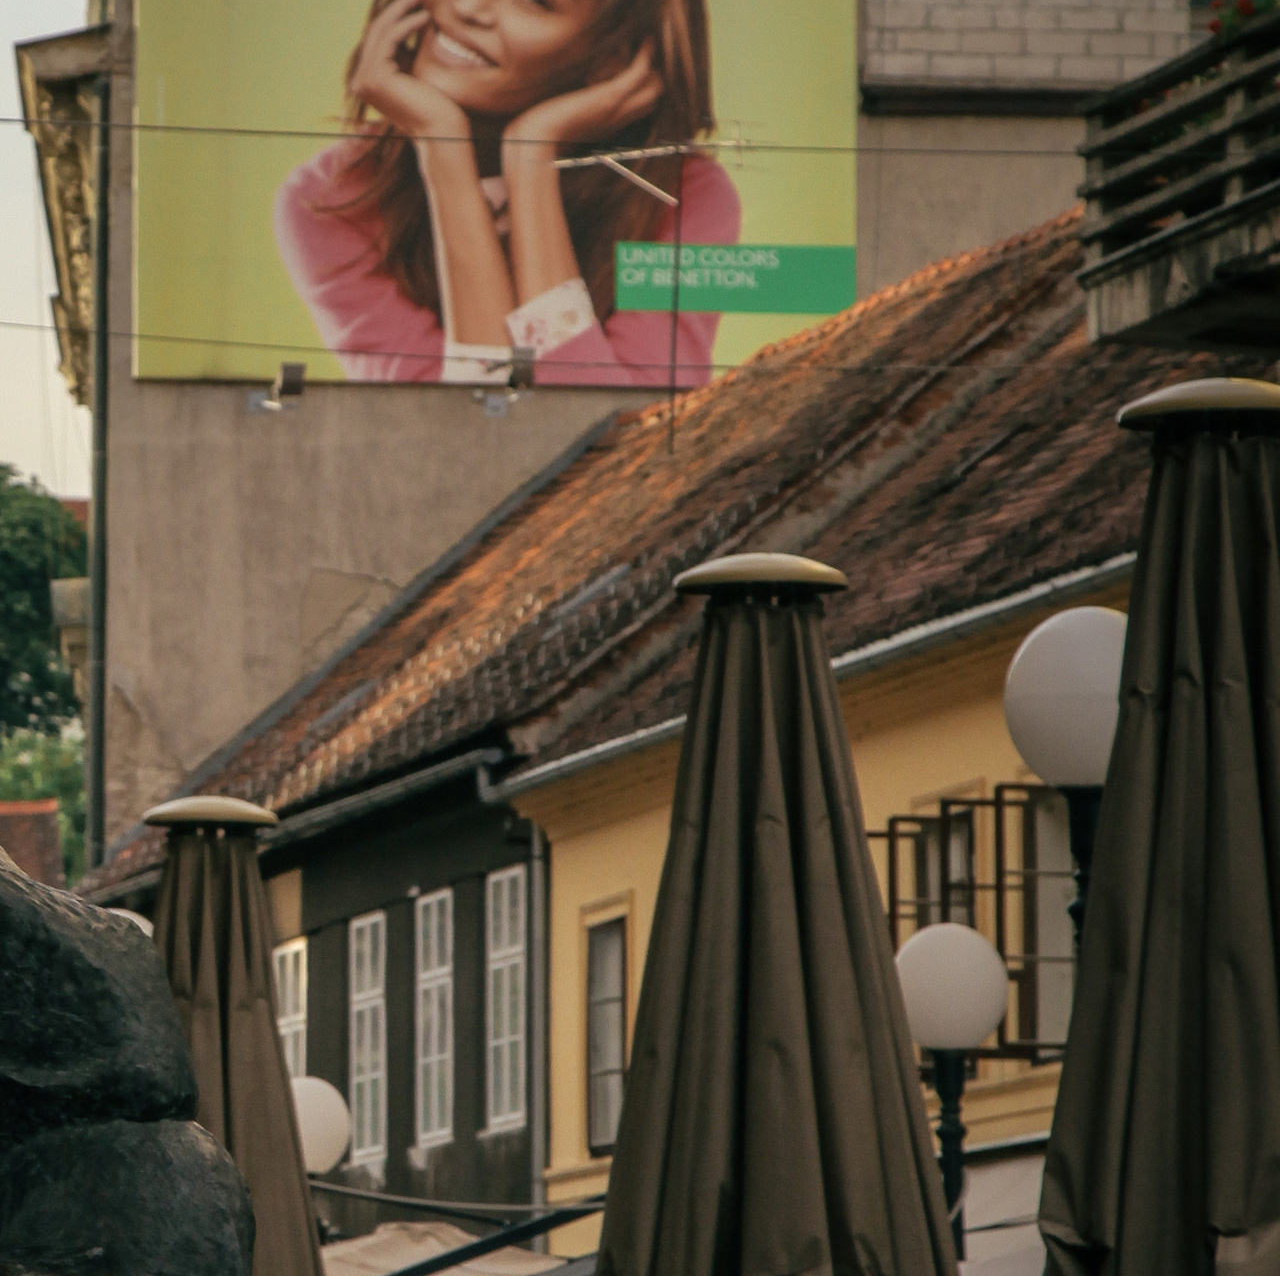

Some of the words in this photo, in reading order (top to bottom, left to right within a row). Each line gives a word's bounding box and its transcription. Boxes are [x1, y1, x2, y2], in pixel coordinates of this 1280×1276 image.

[621, 246, 695, 265] UNITED
[698, 248, 780, 269] COLORS
[621, 267, 645, 286] OF
